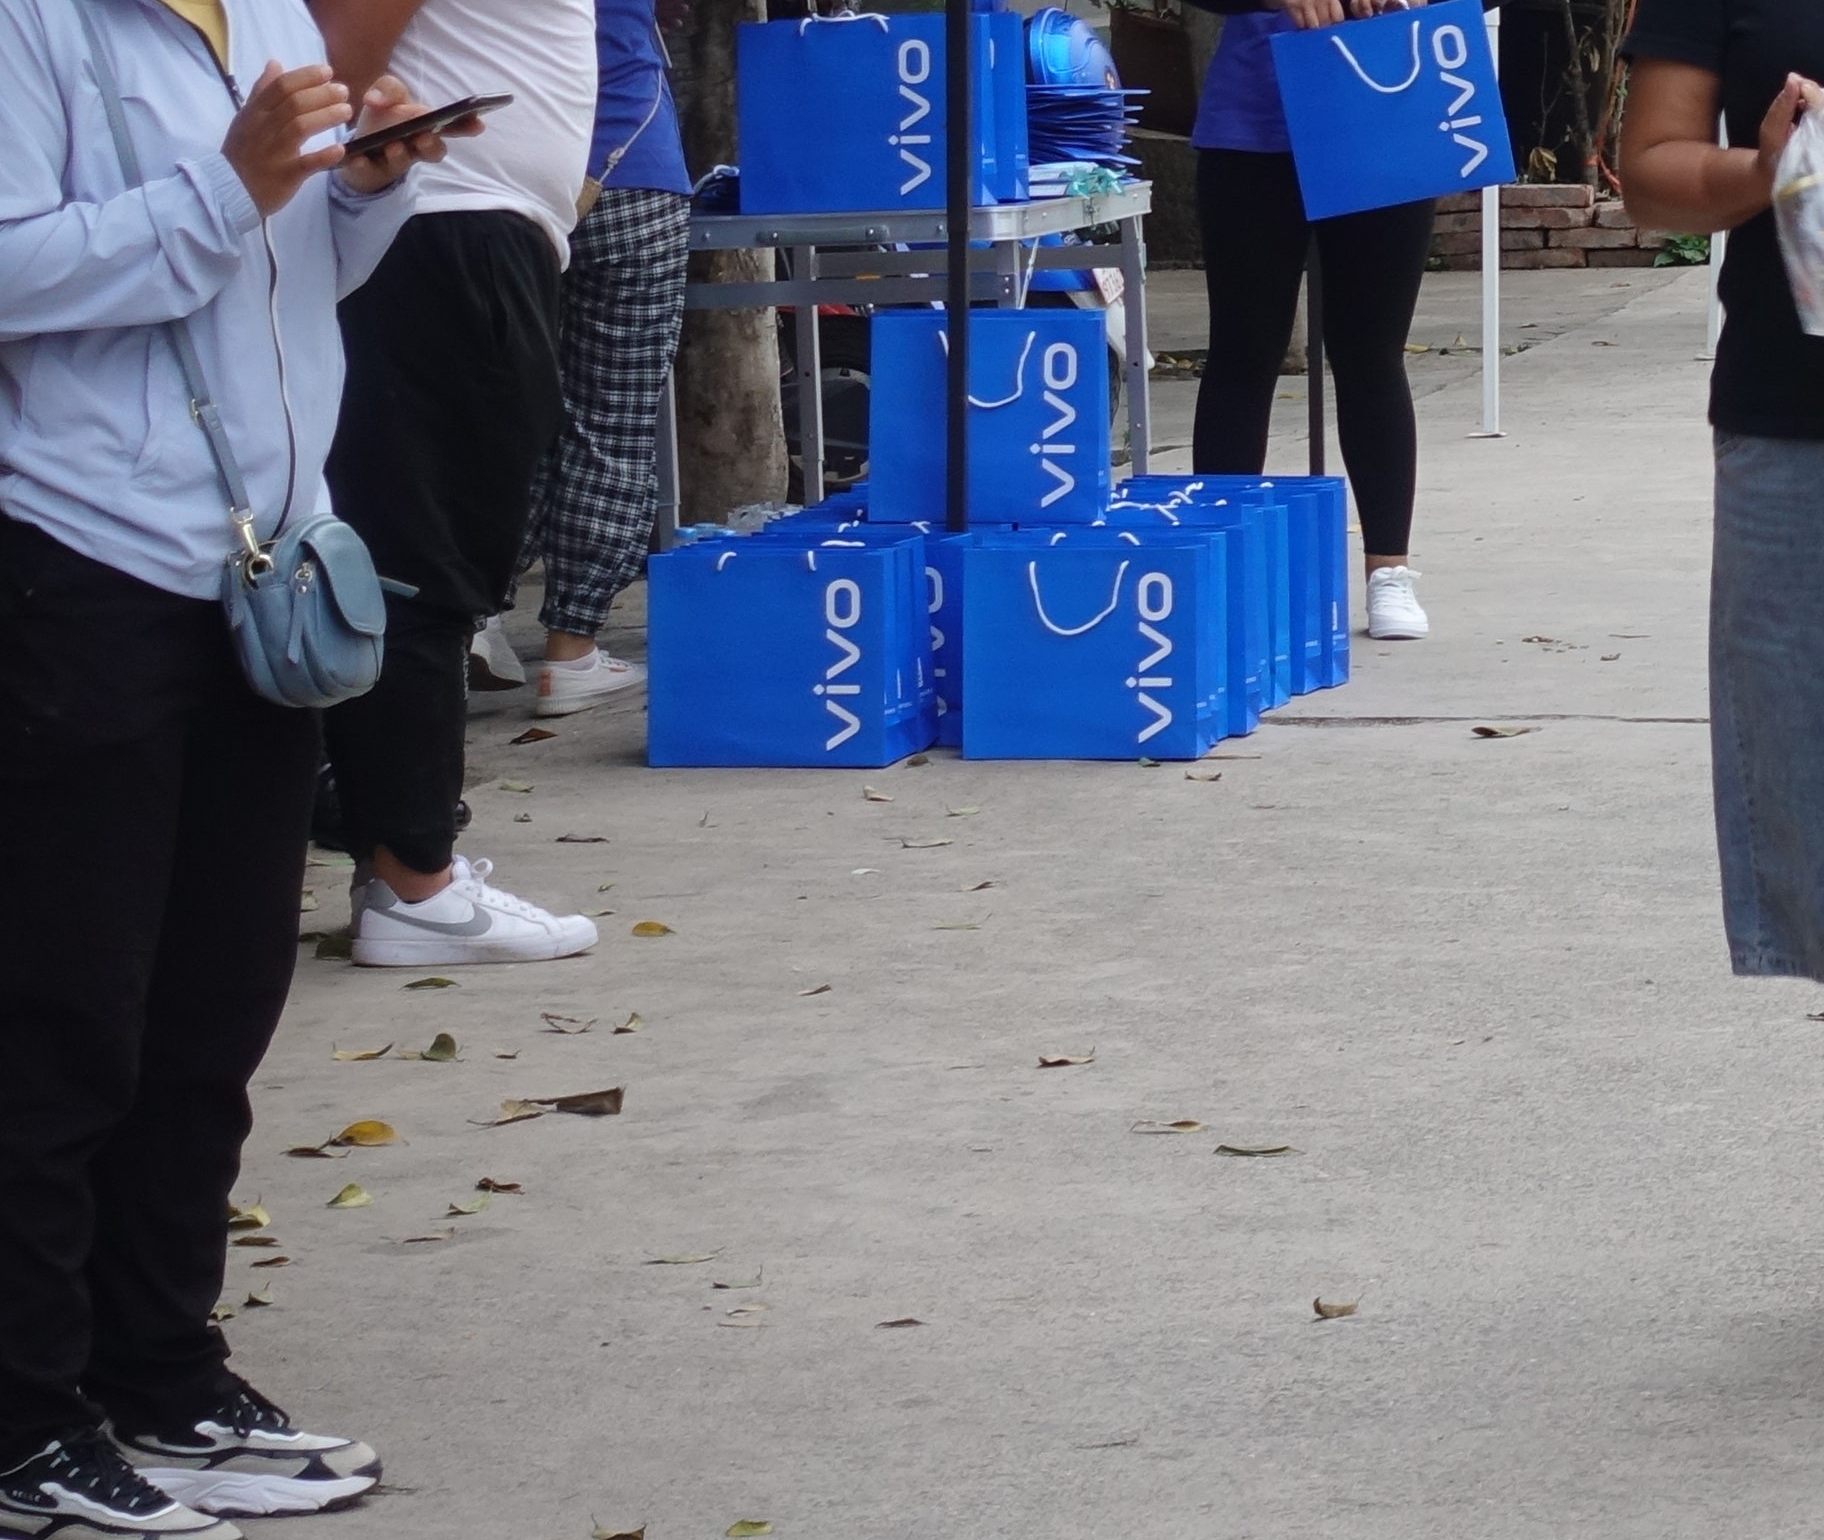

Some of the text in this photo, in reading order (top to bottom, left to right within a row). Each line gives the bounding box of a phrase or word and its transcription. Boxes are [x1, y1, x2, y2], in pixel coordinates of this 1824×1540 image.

[888, 39, 931, 196] vivo
[1432, 23, 1491, 180] vivo
[1029, 342, 1078, 510] vivo
[812, 578, 862, 752] vivo
[1125, 571, 1173, 744] vivo
